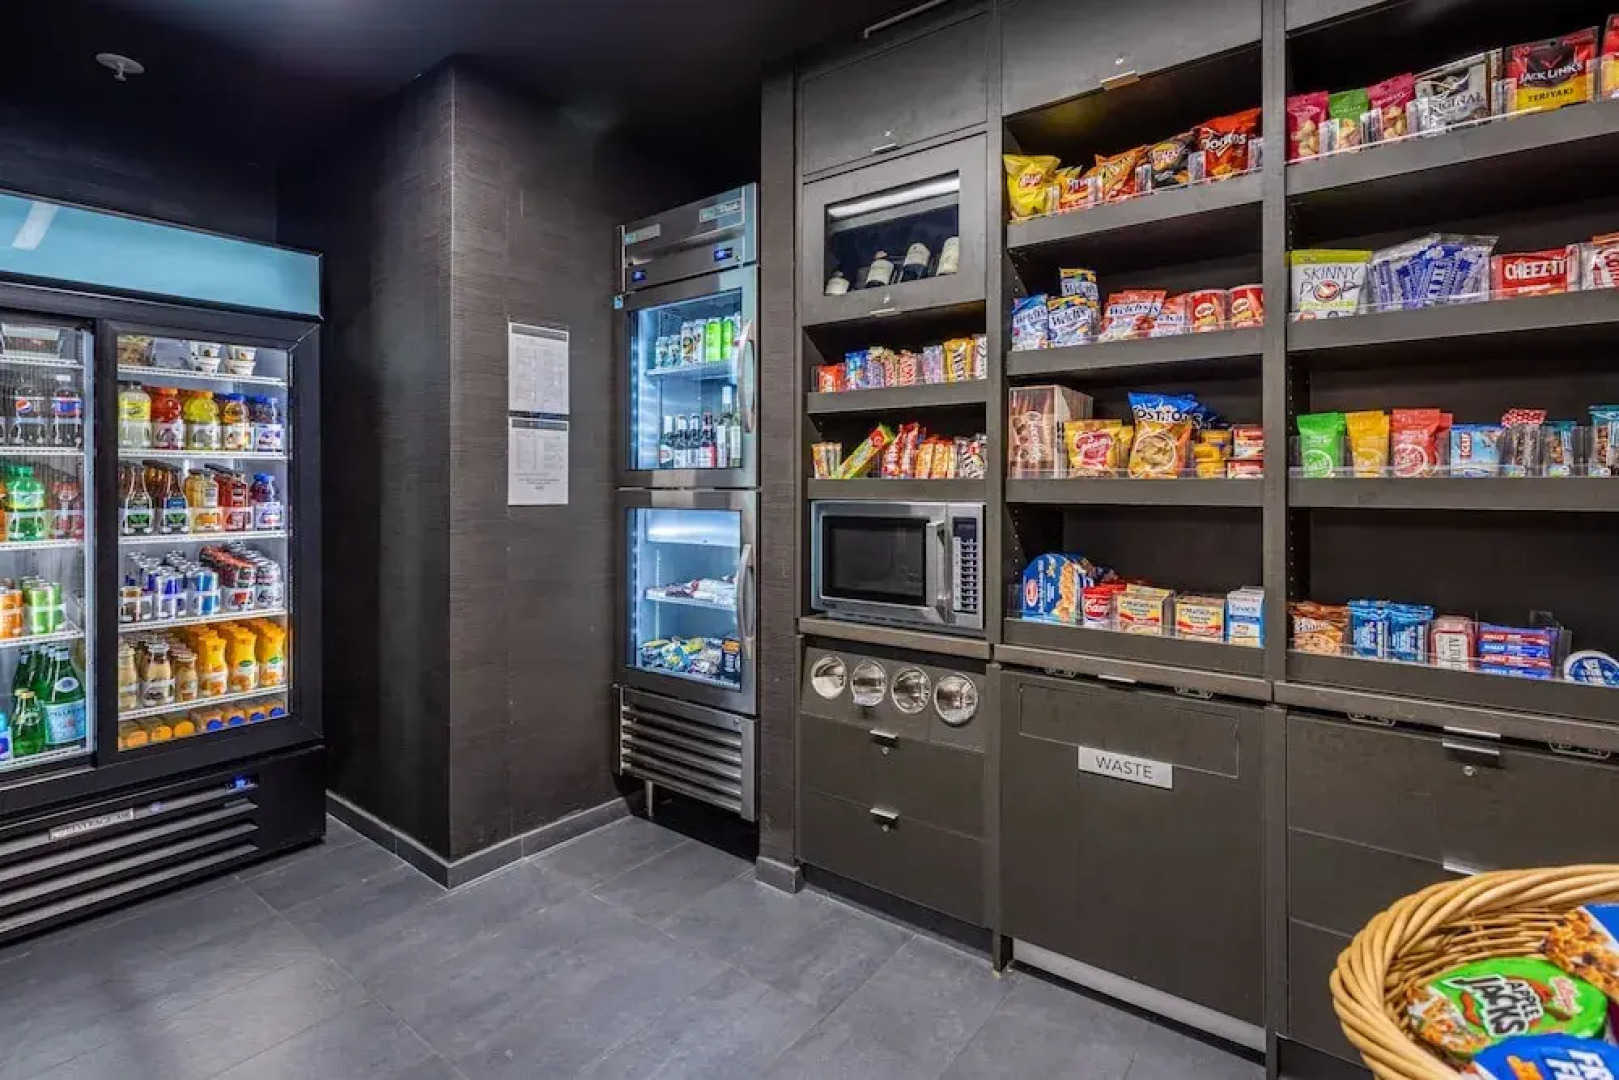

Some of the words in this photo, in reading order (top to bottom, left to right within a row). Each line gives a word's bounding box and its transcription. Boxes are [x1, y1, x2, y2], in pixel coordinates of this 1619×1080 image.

[1527, 87, 1574, 102] TERIYAKI
[1303, 266, 1360, 280] SKINNY
[1096, 755, 1153, 779] WASTE
[1451, 976, 1526, 1035] JACKS
[1510, 982, 1541, 1018] APPLE
